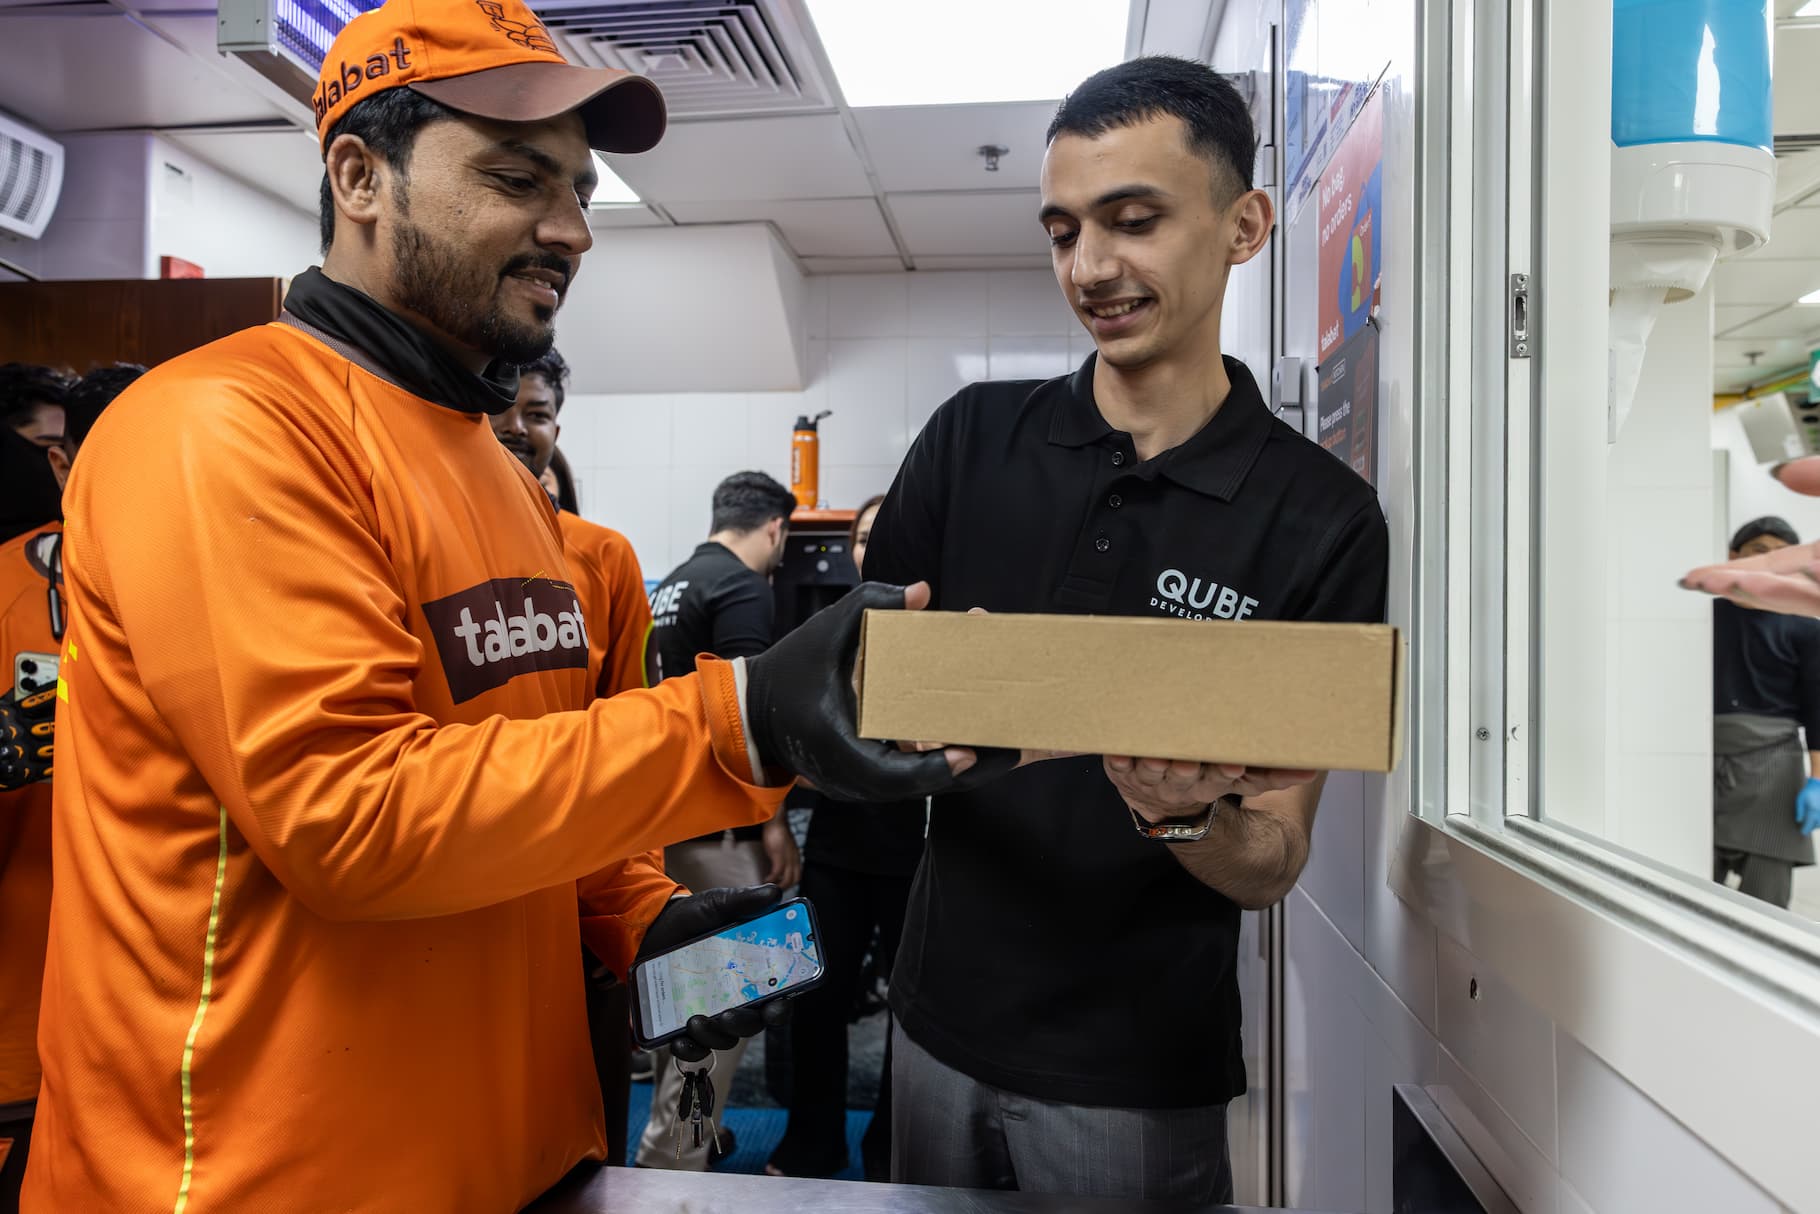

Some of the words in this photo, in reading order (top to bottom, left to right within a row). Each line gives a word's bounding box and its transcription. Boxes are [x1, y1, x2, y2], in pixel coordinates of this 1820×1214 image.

[1322, 186, 1331, 213] No
[1322, 223, 1330, 248] no
[1330, 192, 1352, 235] orders
[648, 580, 689, 616] UBE
[1150, 597, 1213, 622] DEVELOP
[1156, 568, 1259, 622] QUBE
[453, 596, 589, 667] talabat
